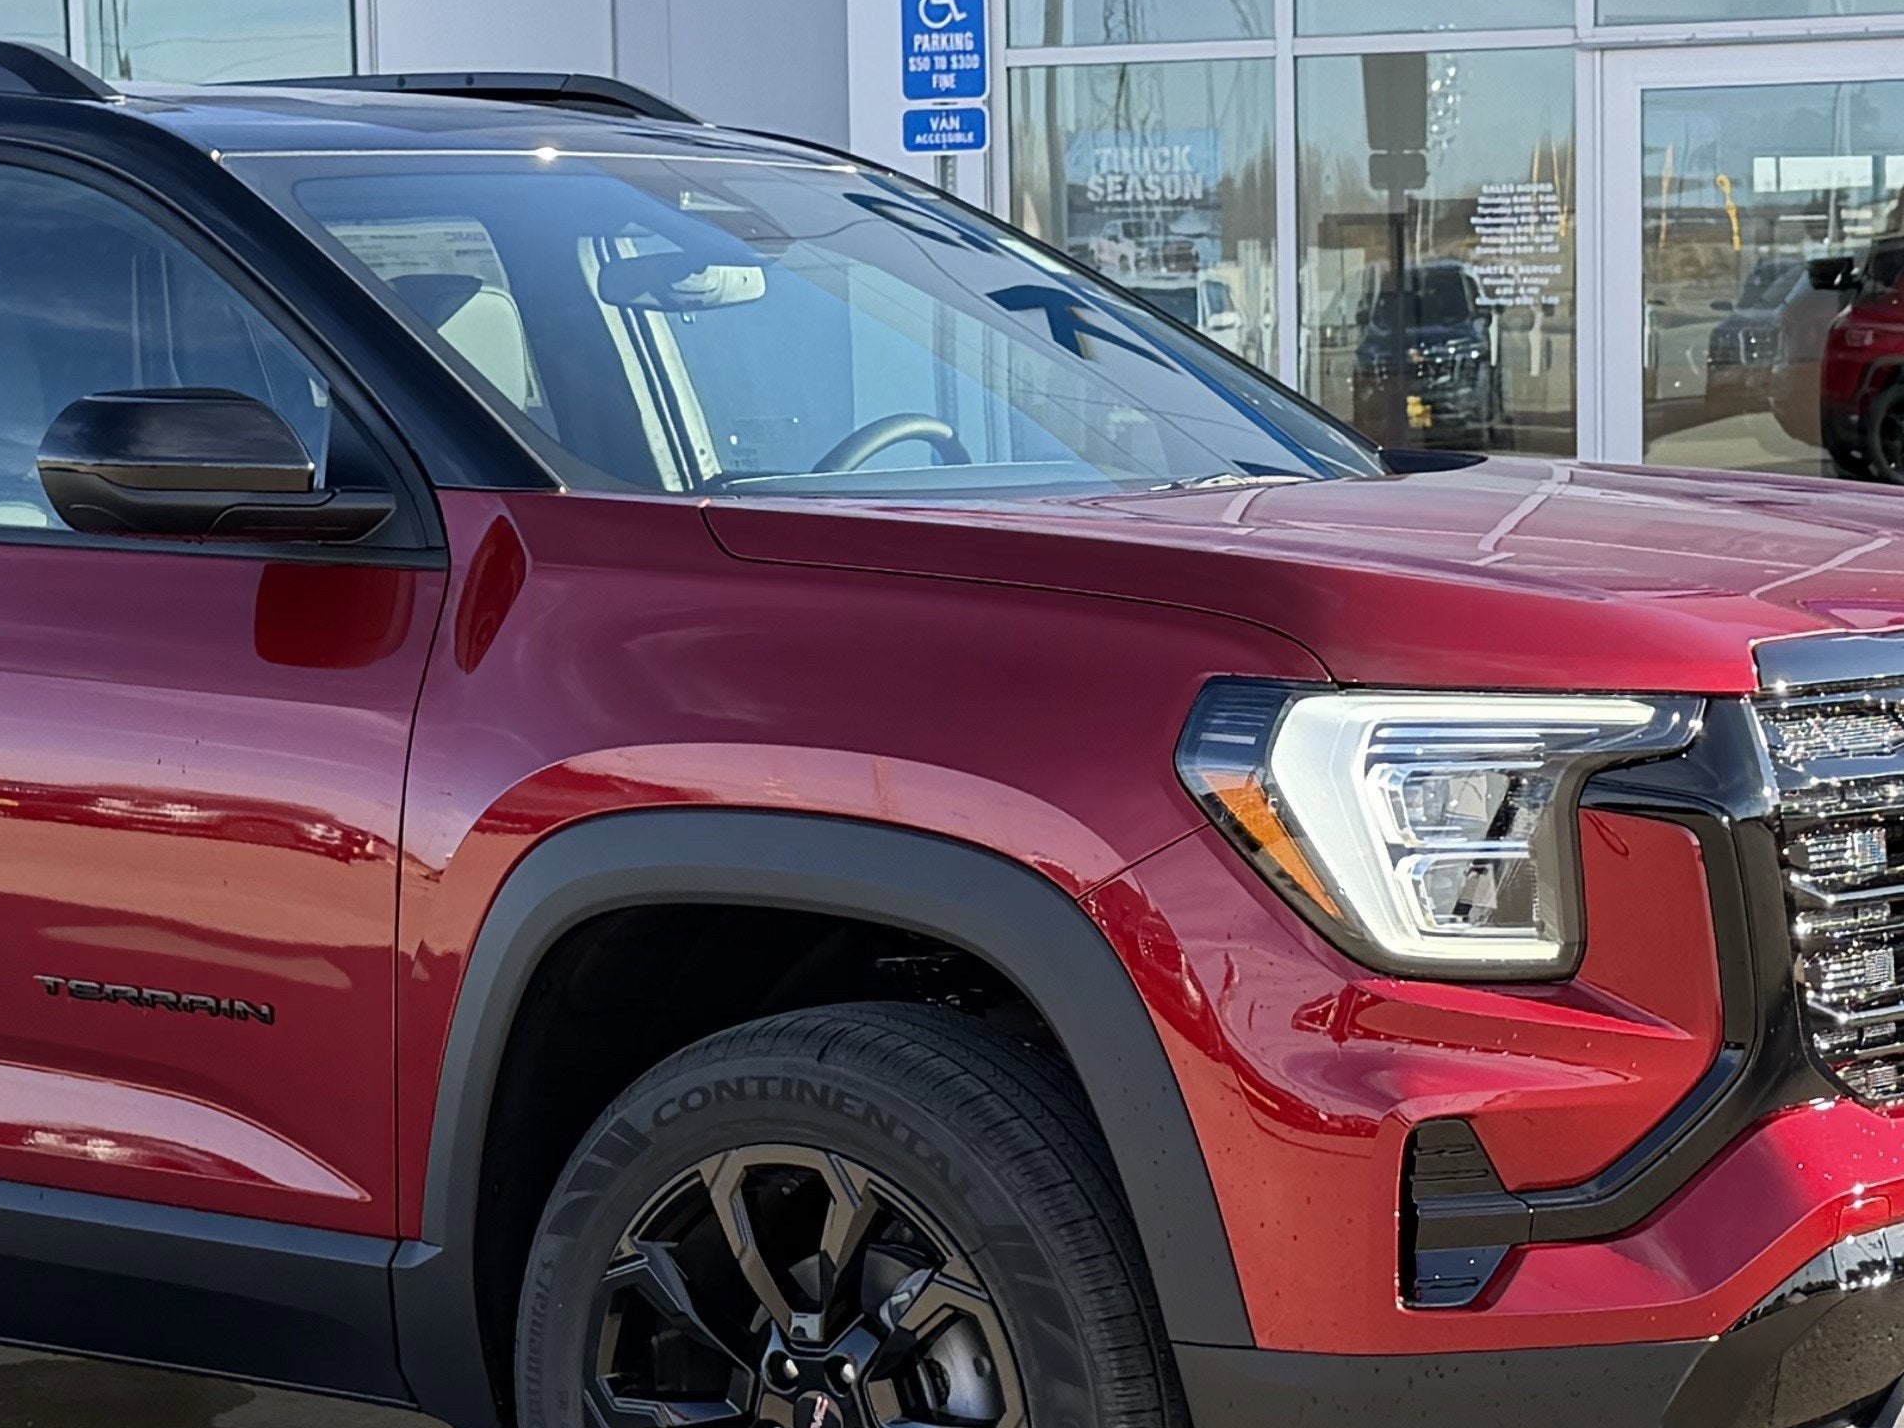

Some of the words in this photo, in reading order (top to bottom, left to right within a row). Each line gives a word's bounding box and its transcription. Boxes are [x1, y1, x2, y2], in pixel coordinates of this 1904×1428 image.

[913, 31, 975, 52] PARKING
[935, 56, 947, 70] TO
[932, 73, 956, 89] FINE
[929, 115, 961, 131] VAN
[1094, 145, 1193, 175] TRUCK
[1086, 172, 1203, 202] SEASON
[33, 974, 275, 1025] TERRAIN
